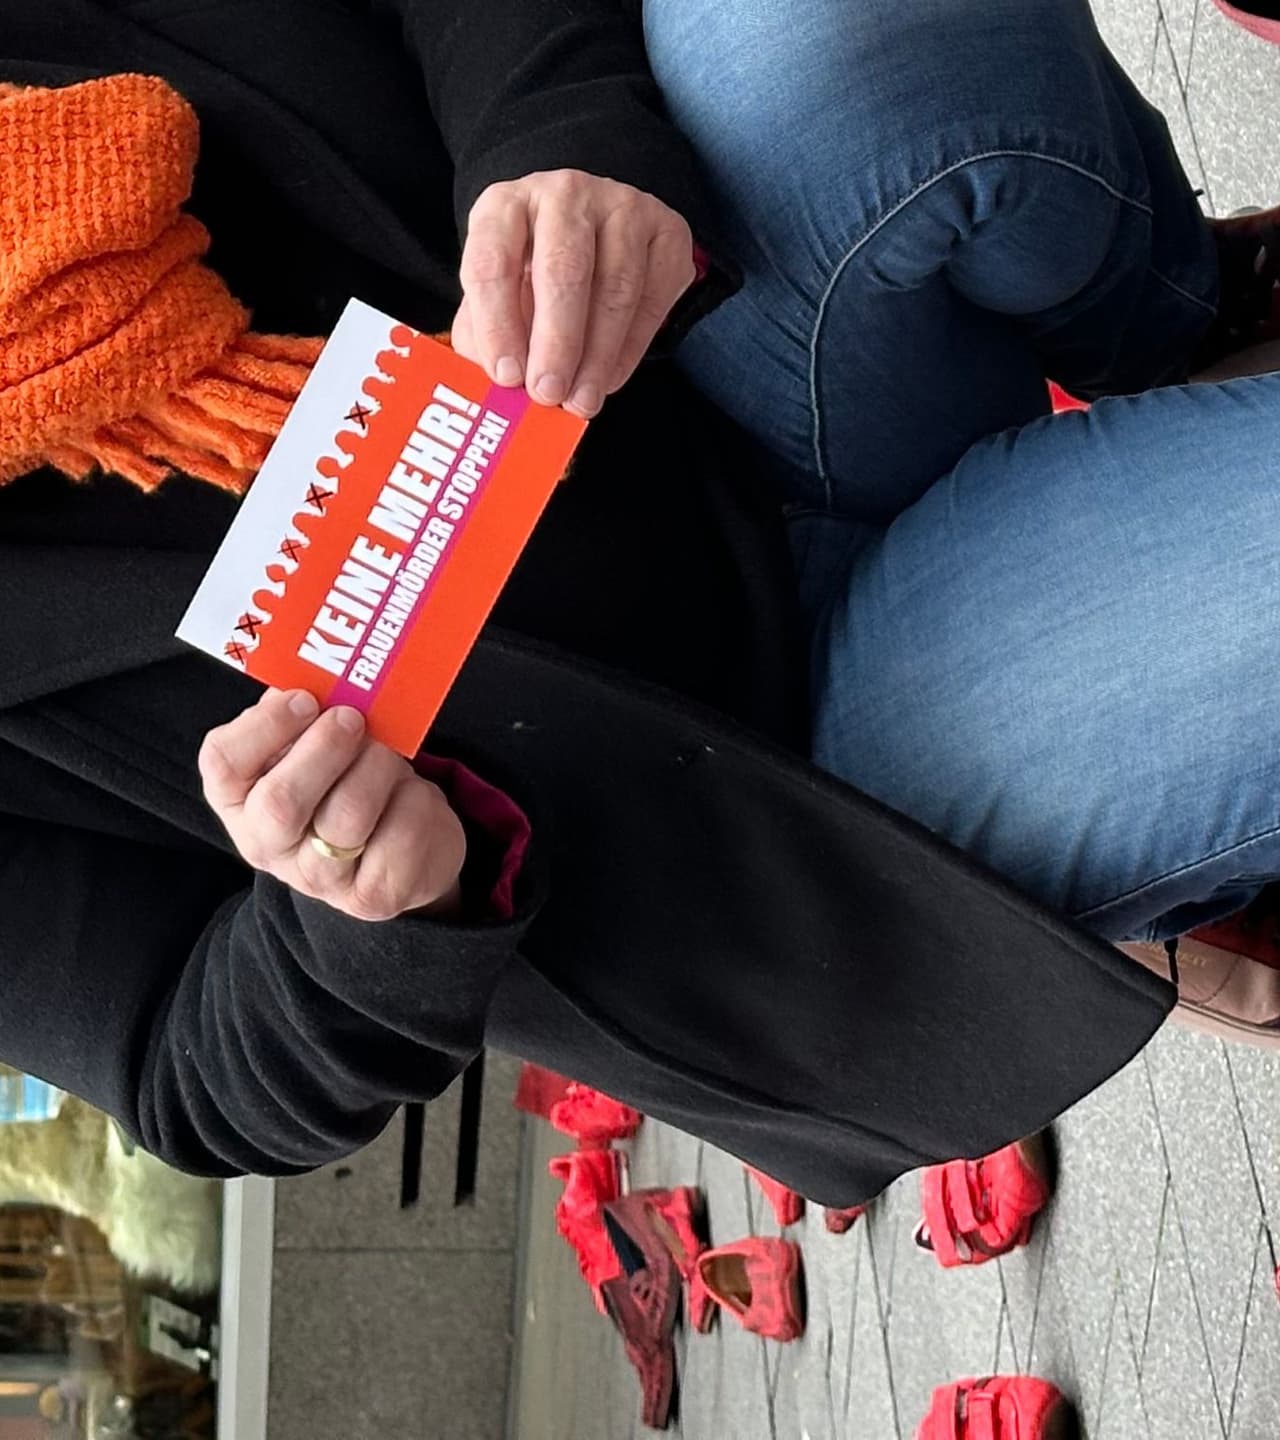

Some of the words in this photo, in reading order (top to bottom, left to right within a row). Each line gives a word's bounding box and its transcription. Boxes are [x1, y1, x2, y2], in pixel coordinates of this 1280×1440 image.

[297, 535, 402, 678] KEINE
[366, 383, 480, 543] MEHR!
[347, 518, 456, 691] FRAUENMÖRDER
[440, 410, 510, 520] STOPPEN!
